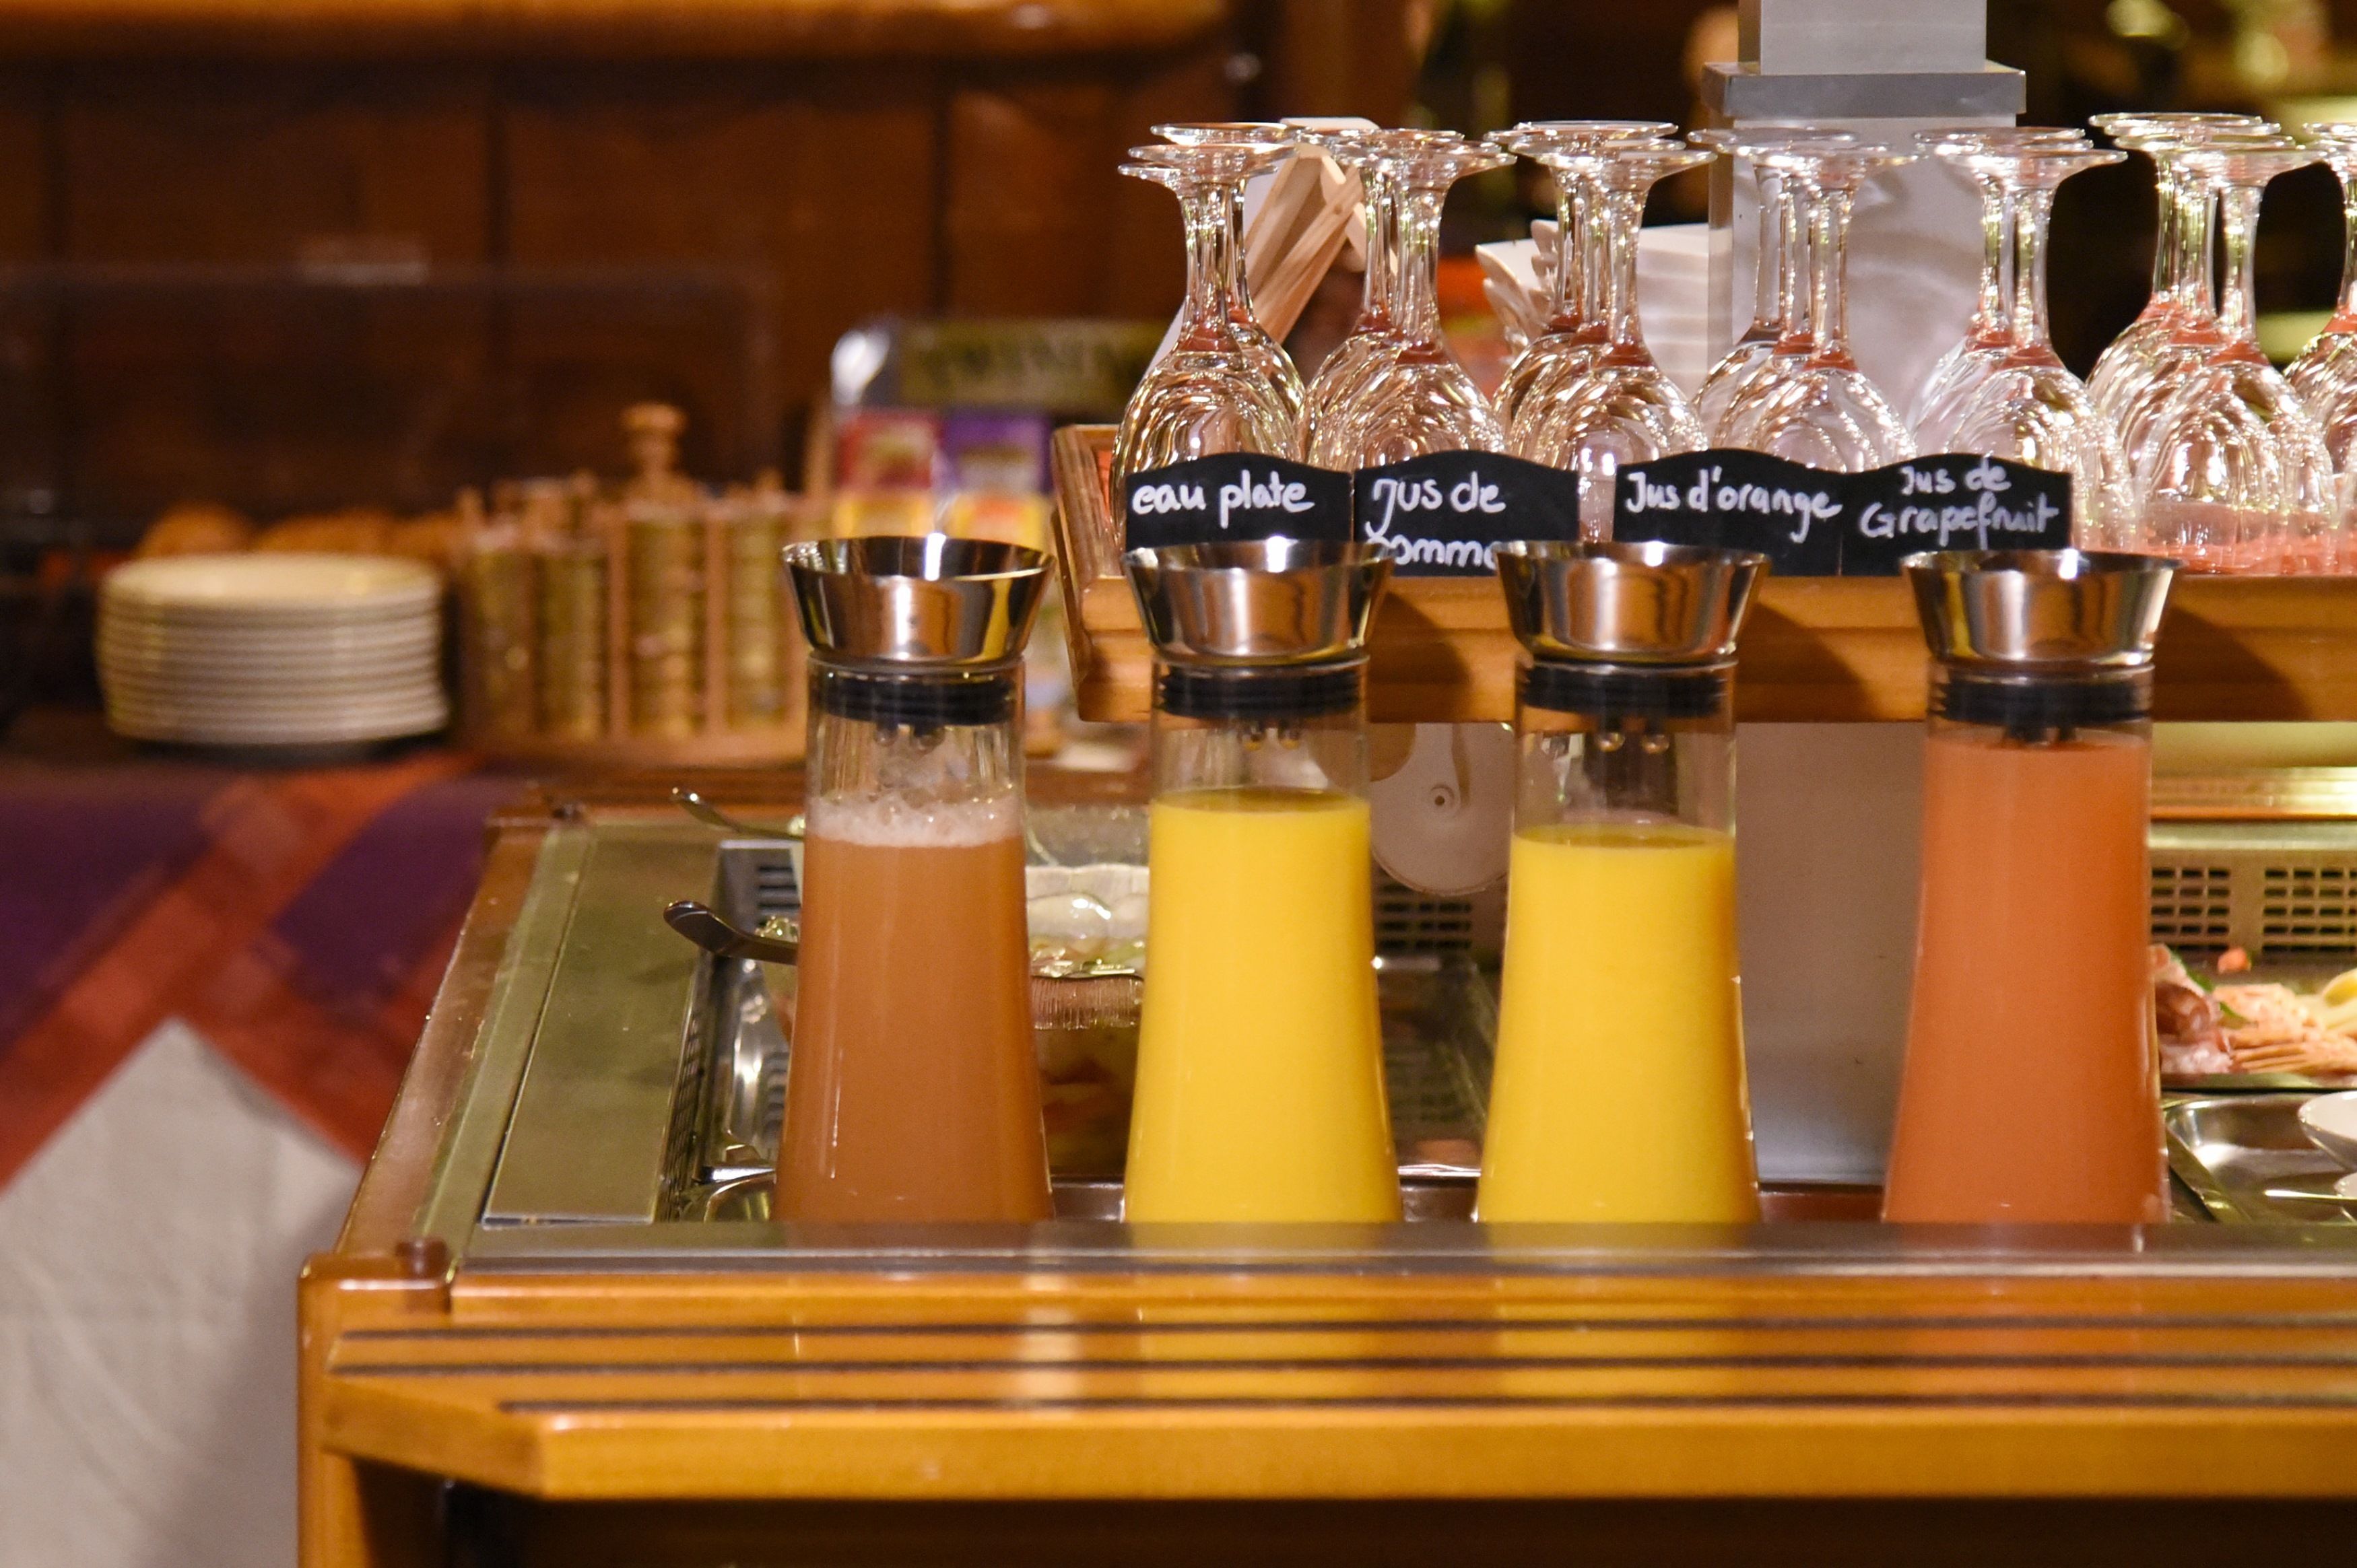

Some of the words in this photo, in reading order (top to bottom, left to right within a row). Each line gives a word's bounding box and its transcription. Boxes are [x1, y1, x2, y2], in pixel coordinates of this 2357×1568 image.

[1131, 484, 1206, 514] eau
[1220, 469, 1315, 529] plate
[1900, 465, 1956, 496] Jus
[1965, 452, 2012, 491] de
[1364, 479, 1442, 538] Jus
[1451, 471, 1506, 513] de
[1626, 472, 1681, 513] Jus
[1688, 465, 1843, 544] d'orange
[1859, 491, 2059, 550] Grapefruit
